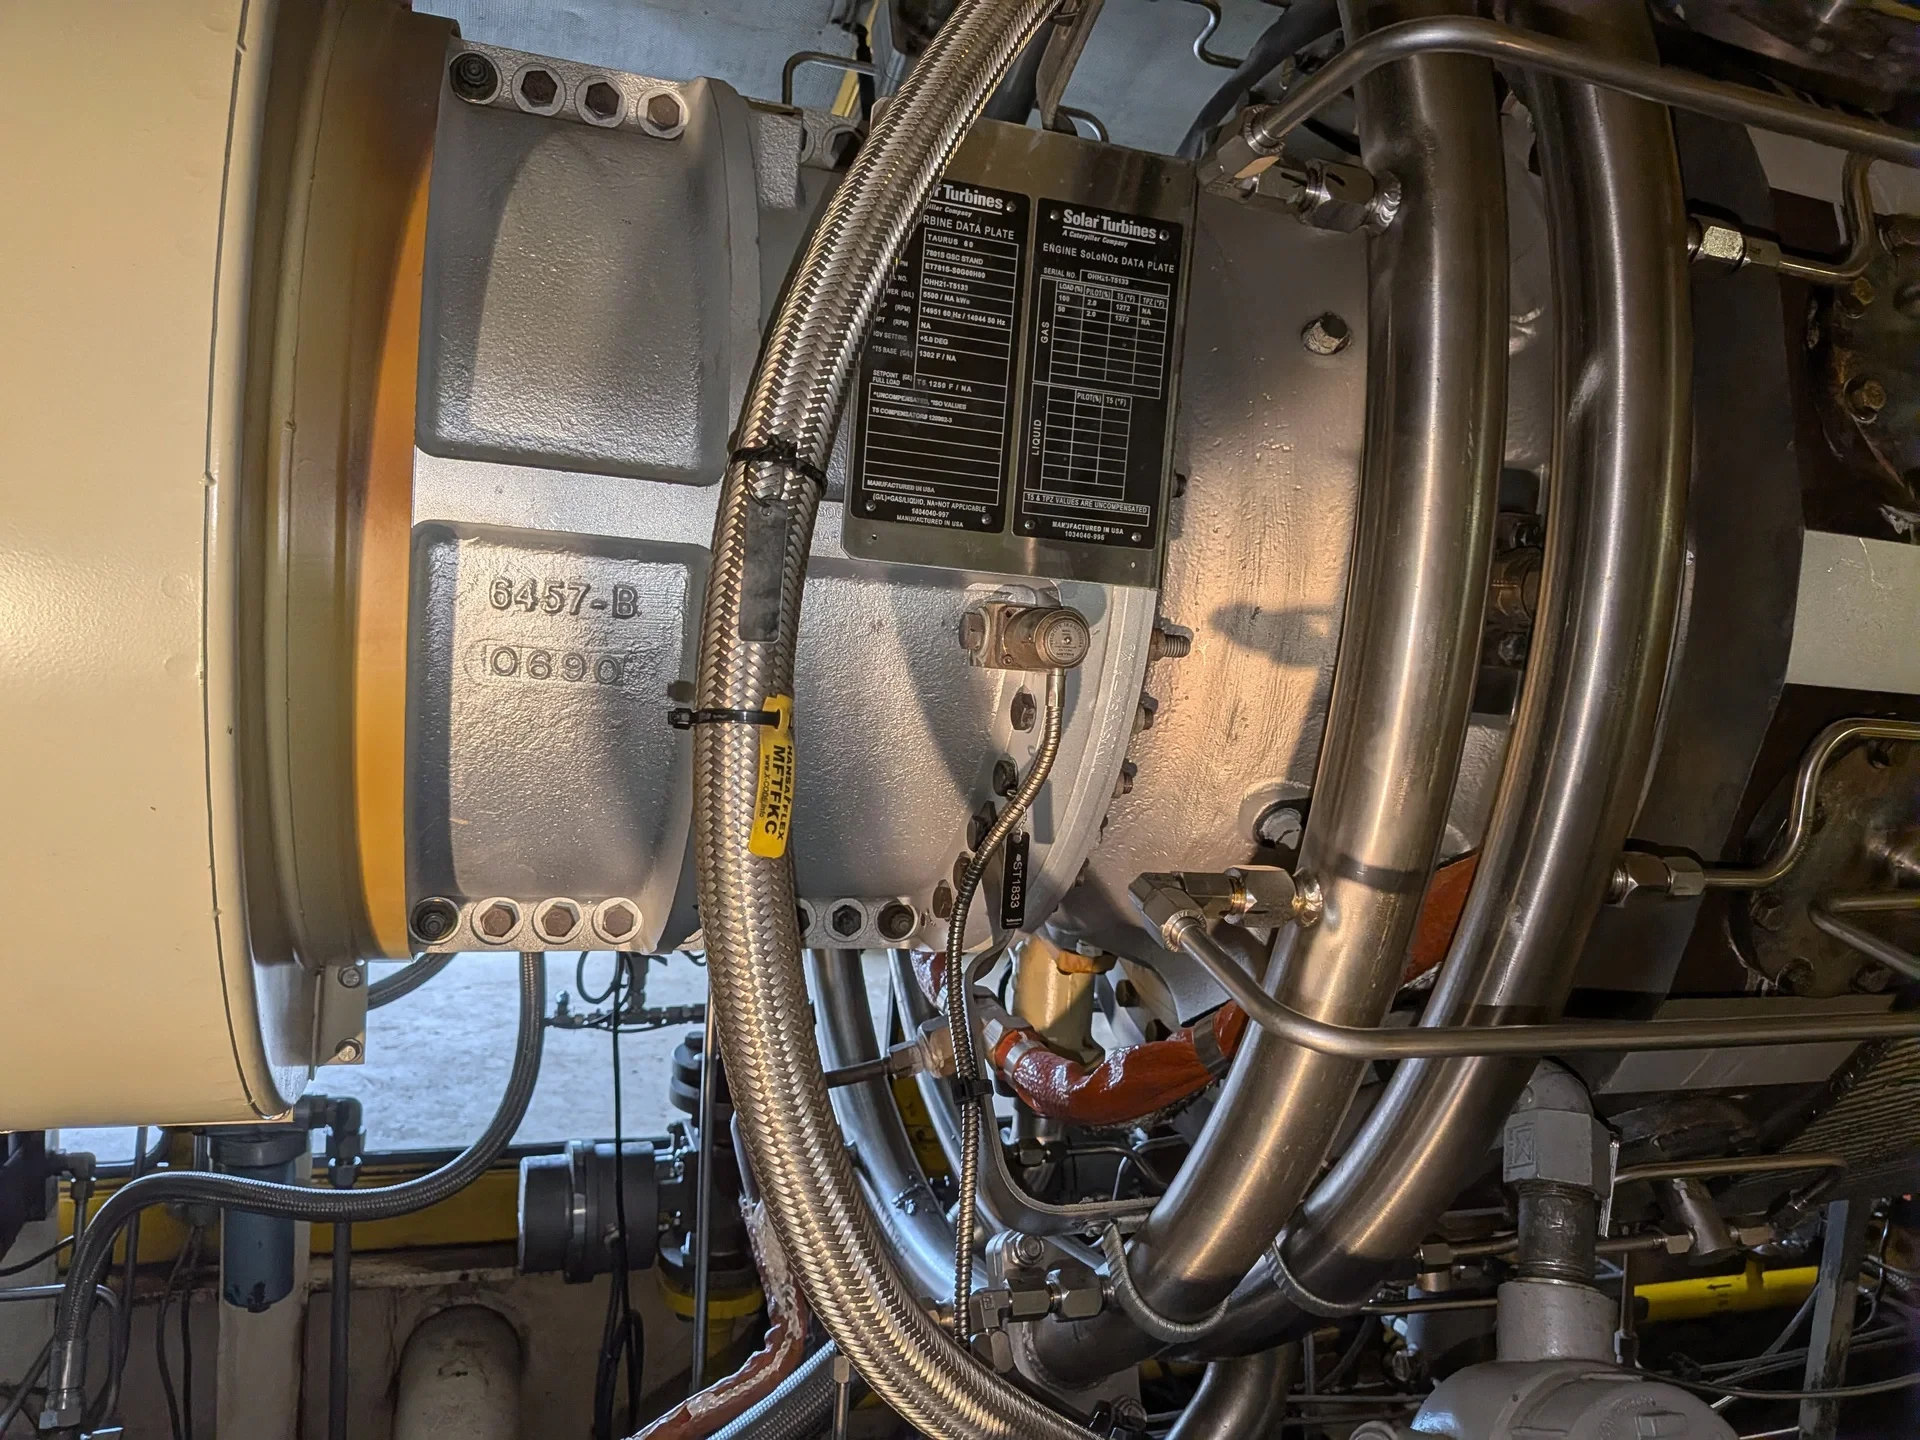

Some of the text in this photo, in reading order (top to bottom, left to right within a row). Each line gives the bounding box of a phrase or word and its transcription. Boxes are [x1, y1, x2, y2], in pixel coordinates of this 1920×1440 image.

[943, 184, 1003, 209] Turbines
[944, 207, 972, 218] Company
[923, 214, 1015, 240] RBINE DATA PLATE
[1063, 209, 1157, 239] Solar Turbines
[927, 234, 959, 246] TAURUS
[1069, 230, 1101, 242] Caterpillar
[1102, 236, 1129, 248] Company
[961, 255, 984, 265] STAND
[1043, 242, 1175, 274] ENGINE SoLoNOx DATA PLATE
[1043, 267, 1077, 279] SERIAL NO.
[1059, 283, 1074, 291] LOAD
[944, 294, 955, 303] NA
[1086, 299, 1098, 307] 2.0
[1116, 304, 1131, 312] 1272
[952, 311, 962, 319] Hz
[996, 318, 1006, 326] Hz
[1086, 310, 1097, 318] 2.0
[1115, 315, 1130, 323] 1272
[920, 322, 932, 330] NA
[884, 332, 908, 341] SETTING
[1040, 321, 1050, 344] GAS
[934, 337, 949, 345] DEG
[882, 346, 898, 355] BASE
[946, 354, 957, 362] NA
[873, 369, 899, 379] SETPOINT
[872, 376, 901, 386] FULL LOAD
[961, 385, 972, 393] NA
[943, 401, 967, 410] VALUES
[1031, 419, 1042, 456] LIQUID
[867, 479, 915, 492] MANUFACTURED
[922, 486, 935, 494] USA
[951, 502, 987, 513] APPLICABLE
[1042, 495, 1054, 503] TPZ
[1055, 496, 1079, 506] VALUES
[1080, 499, 1093, 508] ARE
[1094, 502, 1148, 514] UNCOMPENSATED
[896, 514, 943, 526] MANUFACTURED
[951, 520, 964, 528] USA
[1052, 520, 1102, 532] MANUFACTURED
[1111, 527, 1124, 535] USA
[489, 577, 640, 619] 6457-B
[764, 745, 786, 835] MFTFKC
